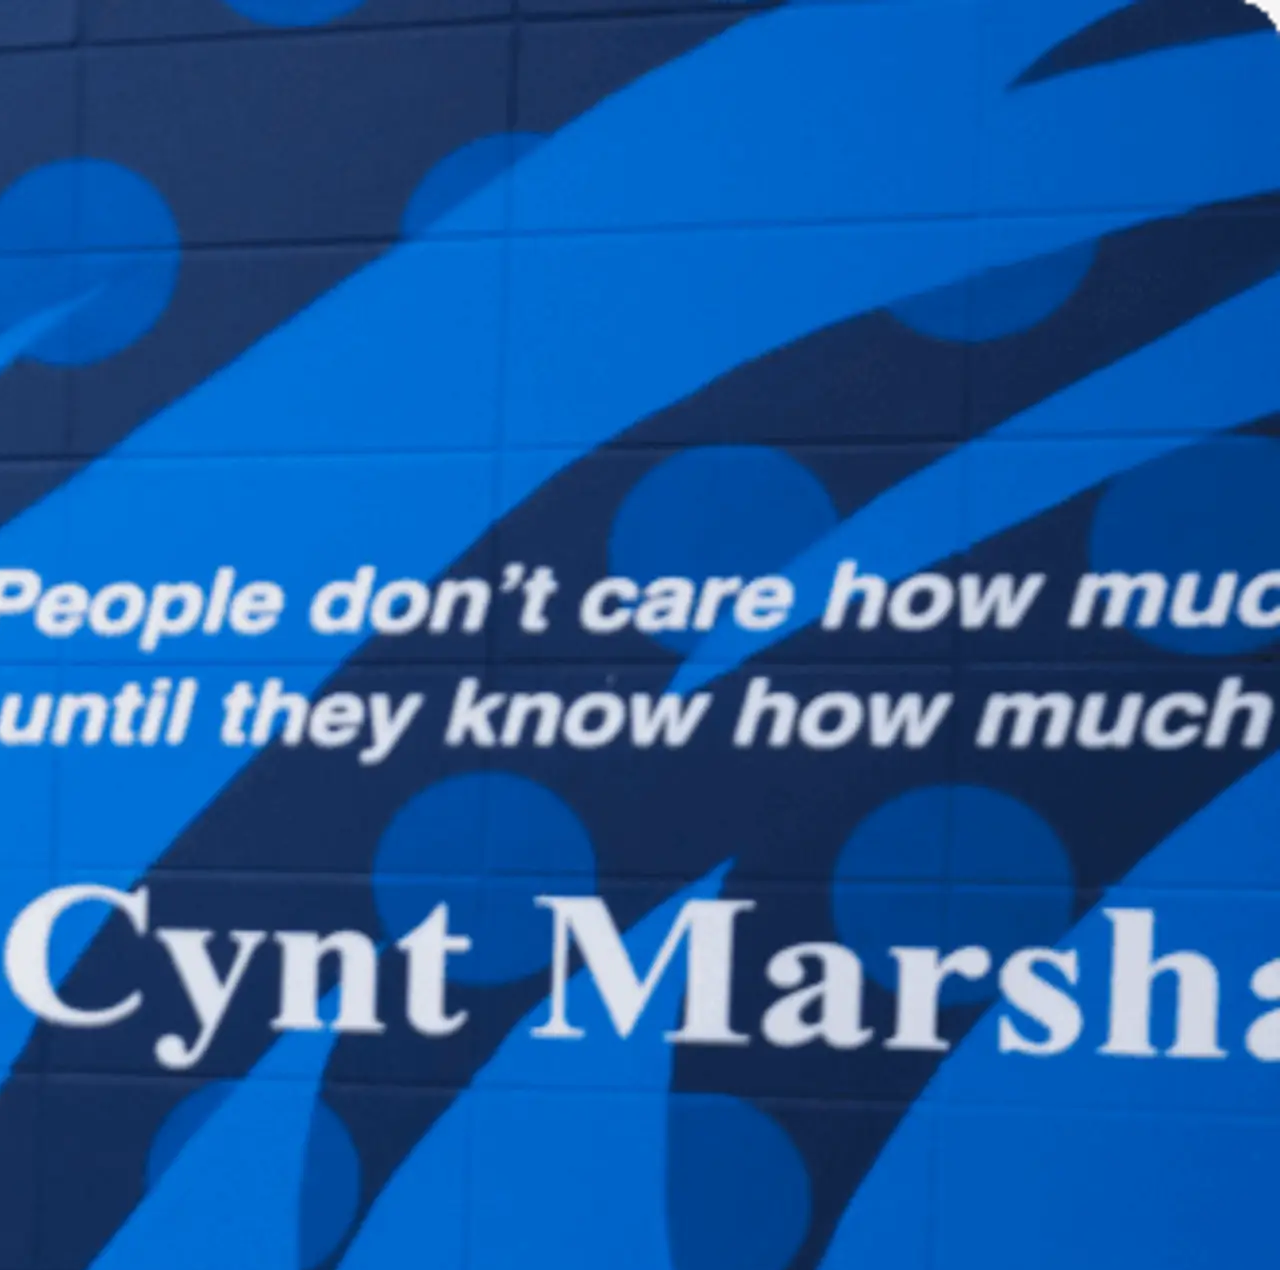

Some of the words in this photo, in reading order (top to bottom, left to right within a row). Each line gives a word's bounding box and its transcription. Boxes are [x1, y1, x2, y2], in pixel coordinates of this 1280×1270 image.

[309, 564, 558, 635] don’t
[579, 576, 795, 633] care
[821, 560, 1045, 631] how
[220, 677, 424, 765] they
[445, 676, 712, 748] know
[733, 676, 953, 749] how
[976, 676, 1273, 749] much
[3, 883, 471, 1069] Cynt
